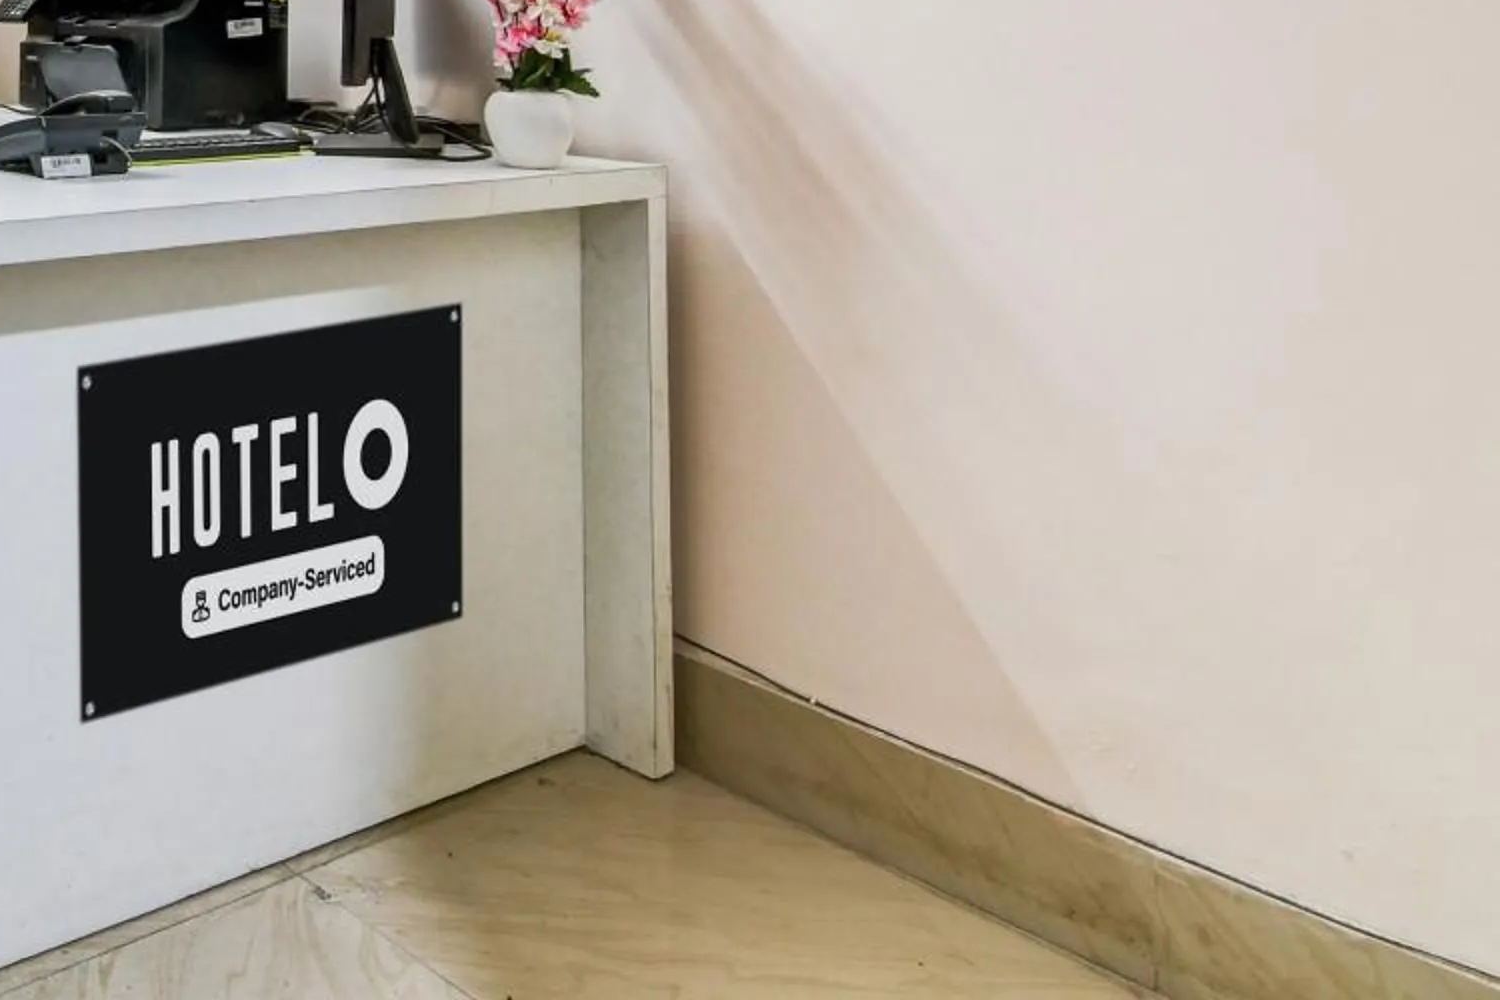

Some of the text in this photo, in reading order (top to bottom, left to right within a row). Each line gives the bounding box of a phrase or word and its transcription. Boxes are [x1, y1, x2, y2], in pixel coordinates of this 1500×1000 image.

[151, 399, 409, 558] HOTEL O
[217, 551, 376, 613] Company-Serviced
